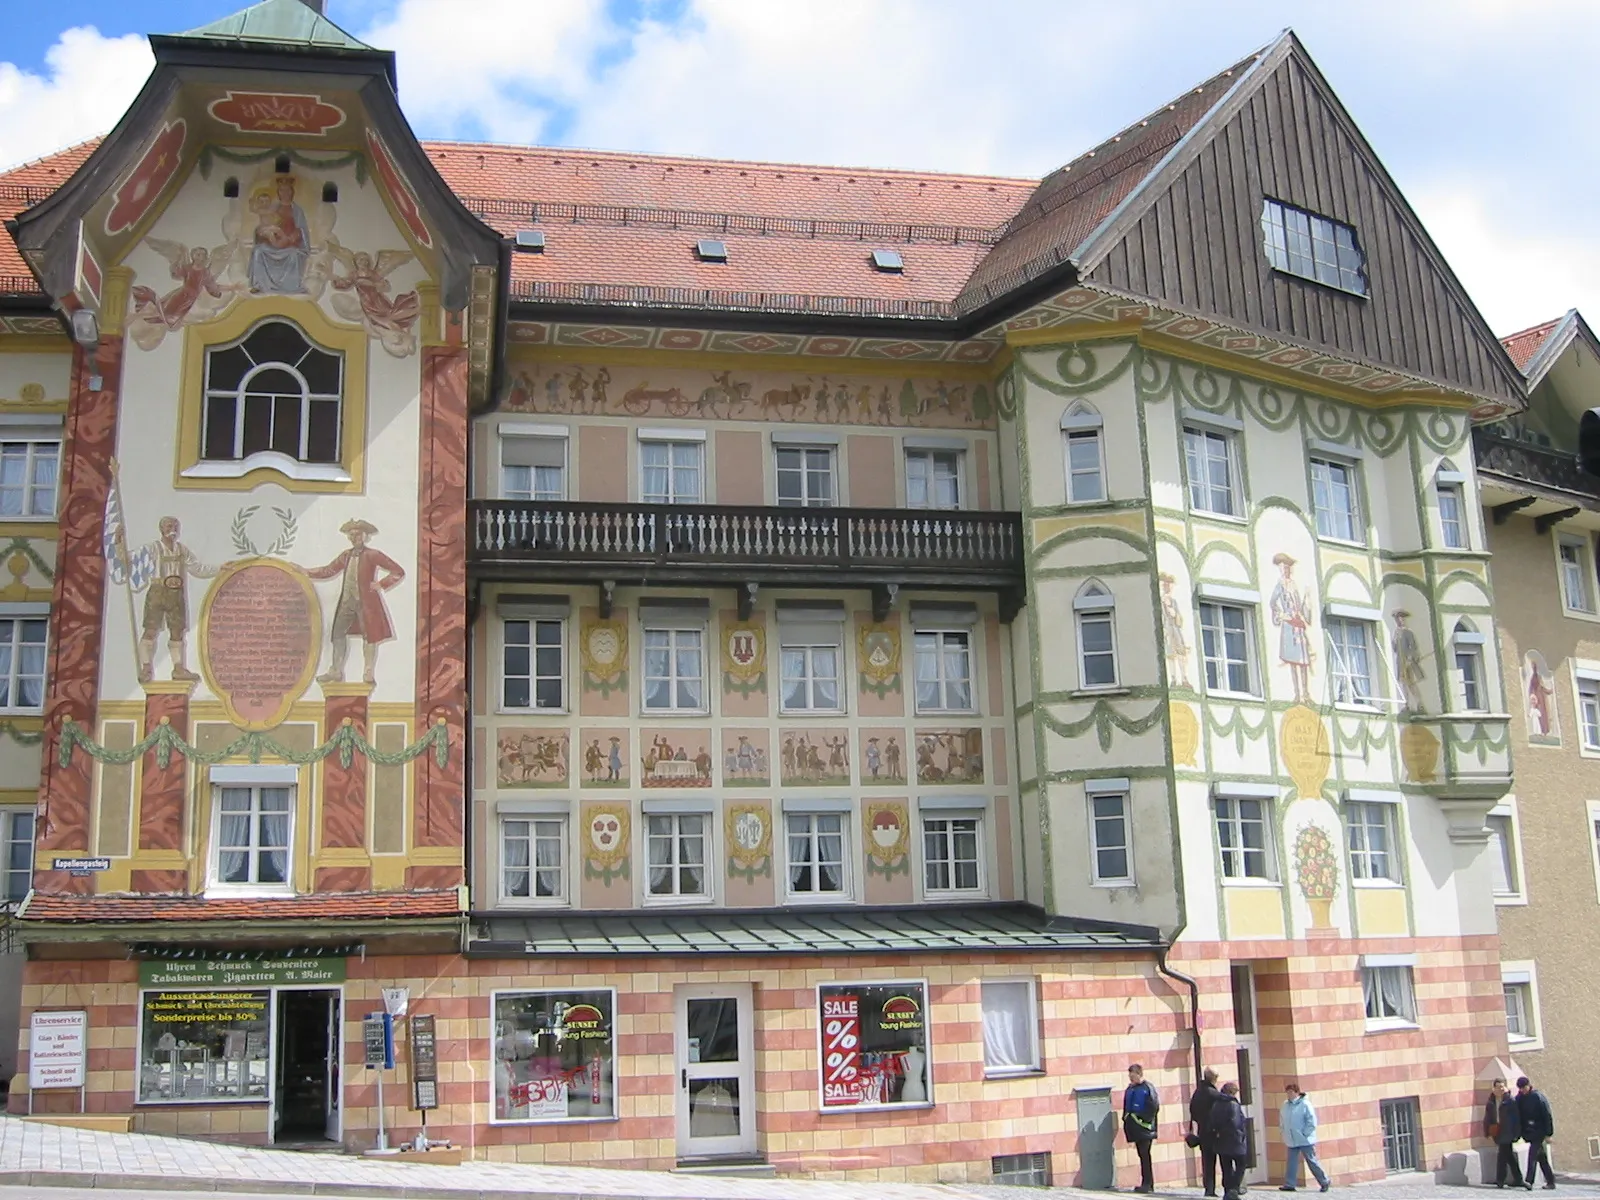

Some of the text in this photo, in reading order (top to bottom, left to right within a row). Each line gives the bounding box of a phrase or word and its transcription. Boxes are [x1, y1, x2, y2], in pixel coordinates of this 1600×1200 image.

[166, 962, 196, 971] Uhren
[207, 960, 252, 971] Schmuck
[151, 973, 214, 983] Tabakwaren
[223, 972, 276, 983] Zigaretten
[824, 1001, 858, 1015] SALE
[153, 1014, 216, 1022] Sonderpreise
[566, 1020, 598, 1029] SUNSET
[880, 1022, 899, 1030] Young
[826, 1020, 857, 1049] %
